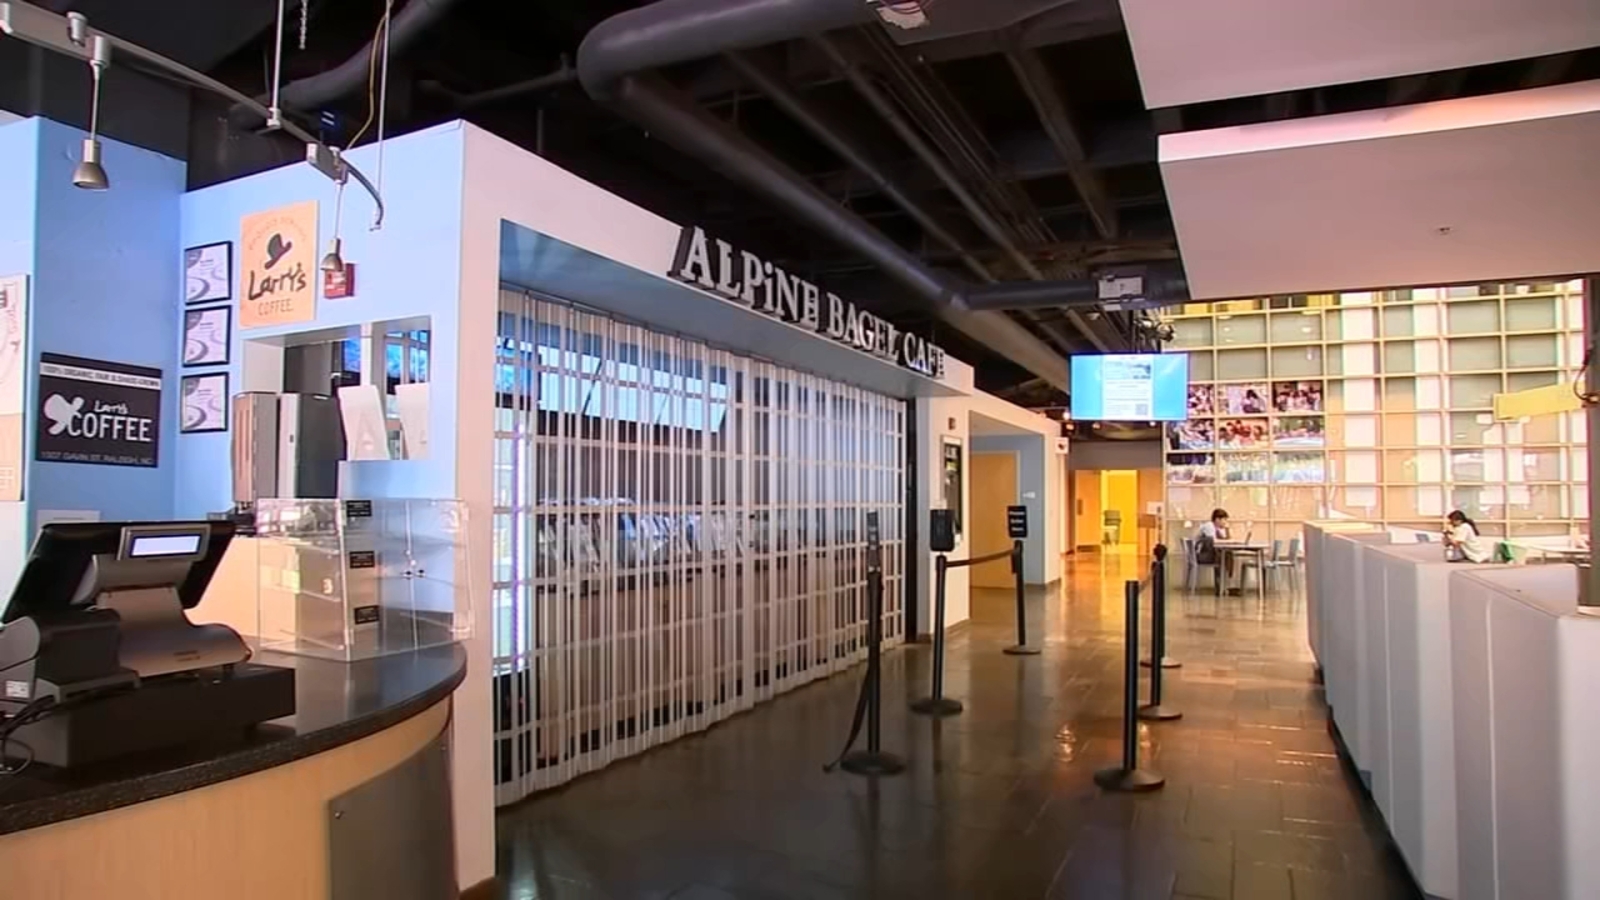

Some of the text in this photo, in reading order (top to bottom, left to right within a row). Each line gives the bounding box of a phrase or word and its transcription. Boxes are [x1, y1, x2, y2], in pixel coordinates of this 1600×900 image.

[258, 298, 295, 316] COFFEE
[825, 291, 899, 362] BAGEL
[68, 412, 153, 442] COFFEE
